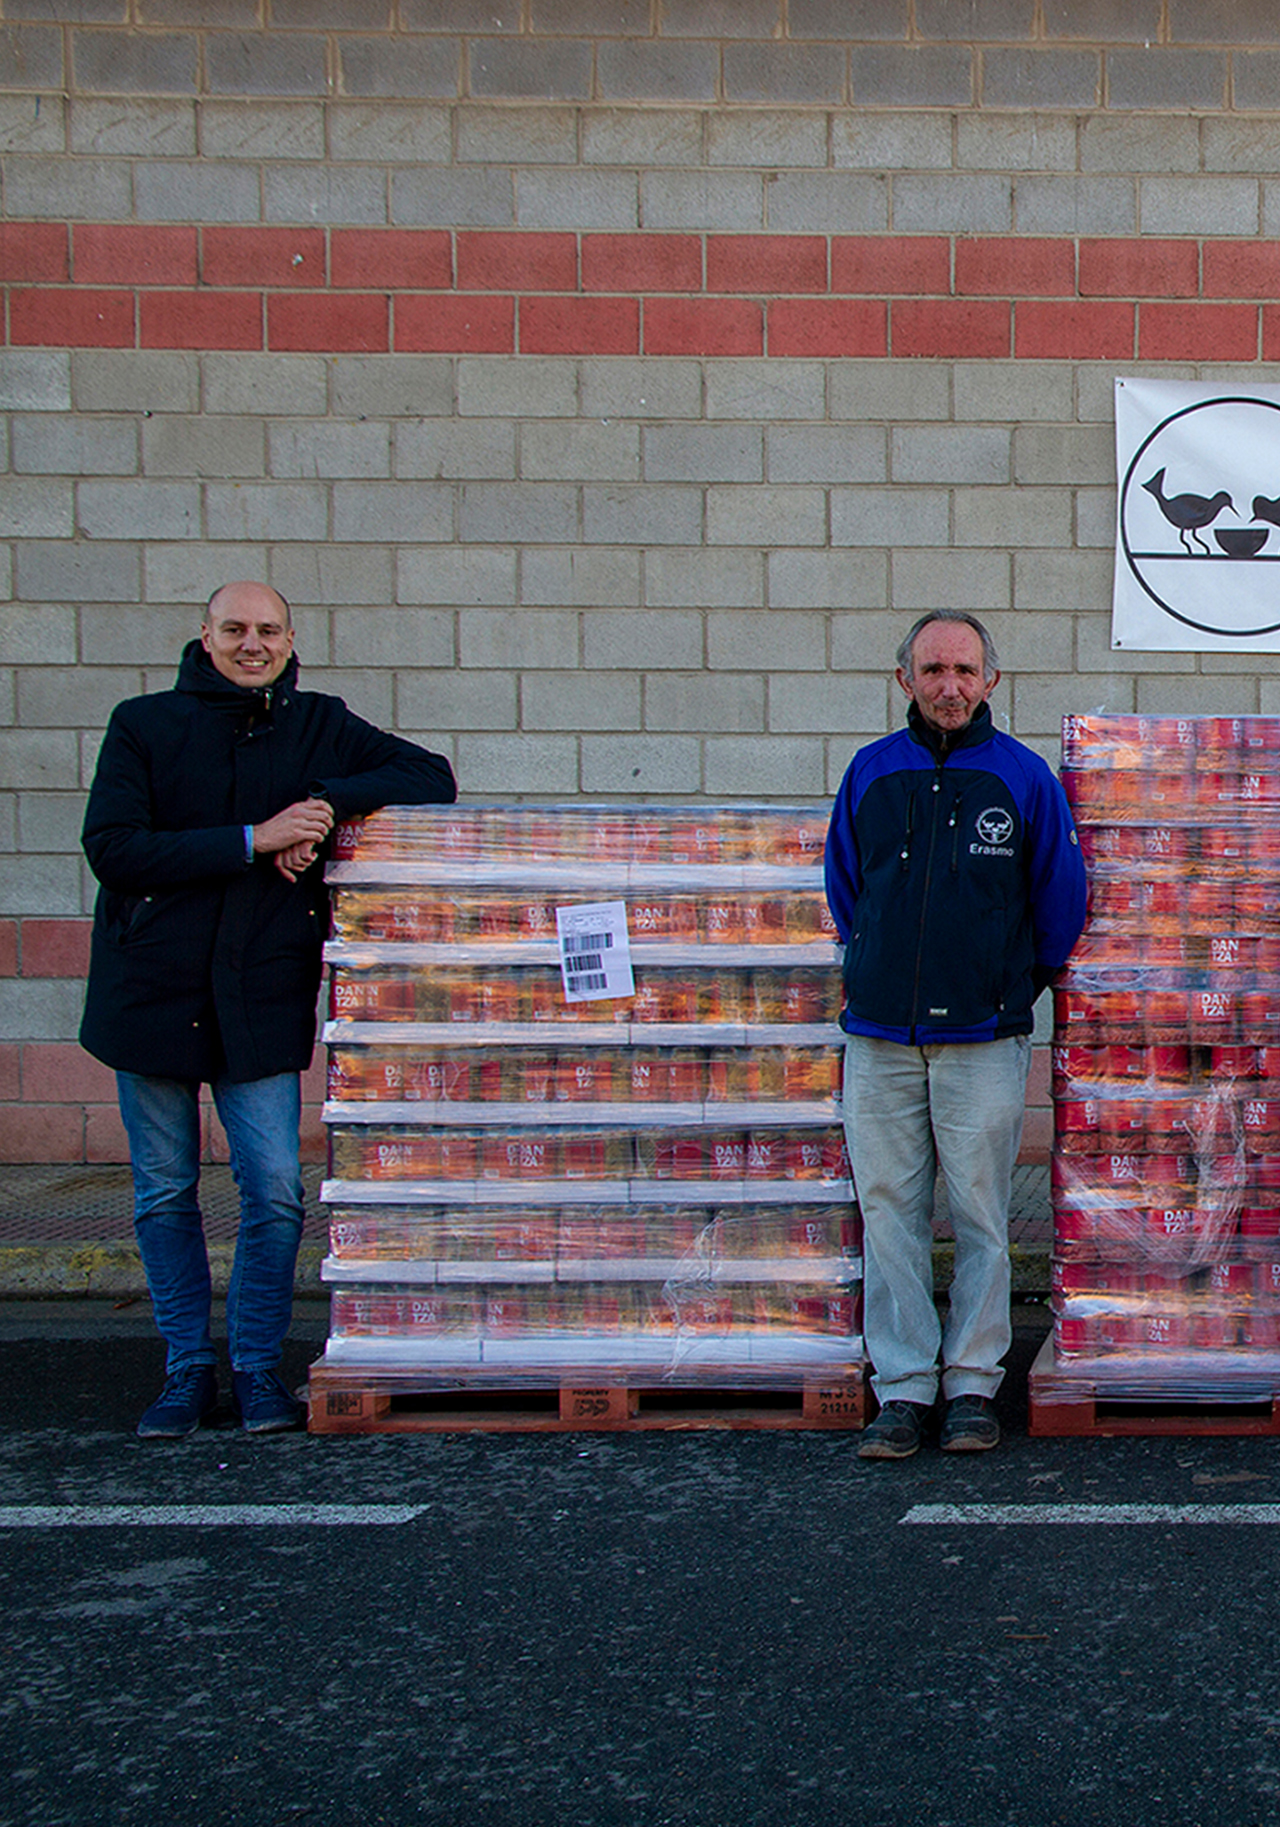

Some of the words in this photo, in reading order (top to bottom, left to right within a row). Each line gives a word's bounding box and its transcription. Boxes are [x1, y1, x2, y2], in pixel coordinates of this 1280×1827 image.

[1243, 777, 1259, 787] AN
[1151, 831, 1170, 841] AN
[969, 843, 1015, 857] Erasmo
[1150, 842, 1163, 851] ZA
[635, 909, 662, 918] DAN
[709, 909, 728, 917] AN
[636, 920, 657, 929] TZA
[709, 920, 722, 929] ZA
[1212, 940, 1239, 949] DAN
[1212, 951, 1233, 961] TZA
[335, 997, 357, 1006] TZA
[1202, 994, 1230, 1004] DAN
[1202, 1006, 1225, 1015] TZA
[633, 1067, 649, 1076] AN
[715, 1145, 744, 1155] DAN
[716, 1157, 737, 1167] TZA
[750, 1157, 764, 1167] ZA
[1111, 1156, 1138, 1166] DAN
[1112, 1168, 1134, 1178] TZA
[1164, 1211, 1192, 1221] DAN
[1164, 1223, 1186, 1232] TZA
[412, 1302, 441, 1312] DAN
[412, 1314, 436, 1322] TZA
[1151, 1320, 1169, 1330] AN
